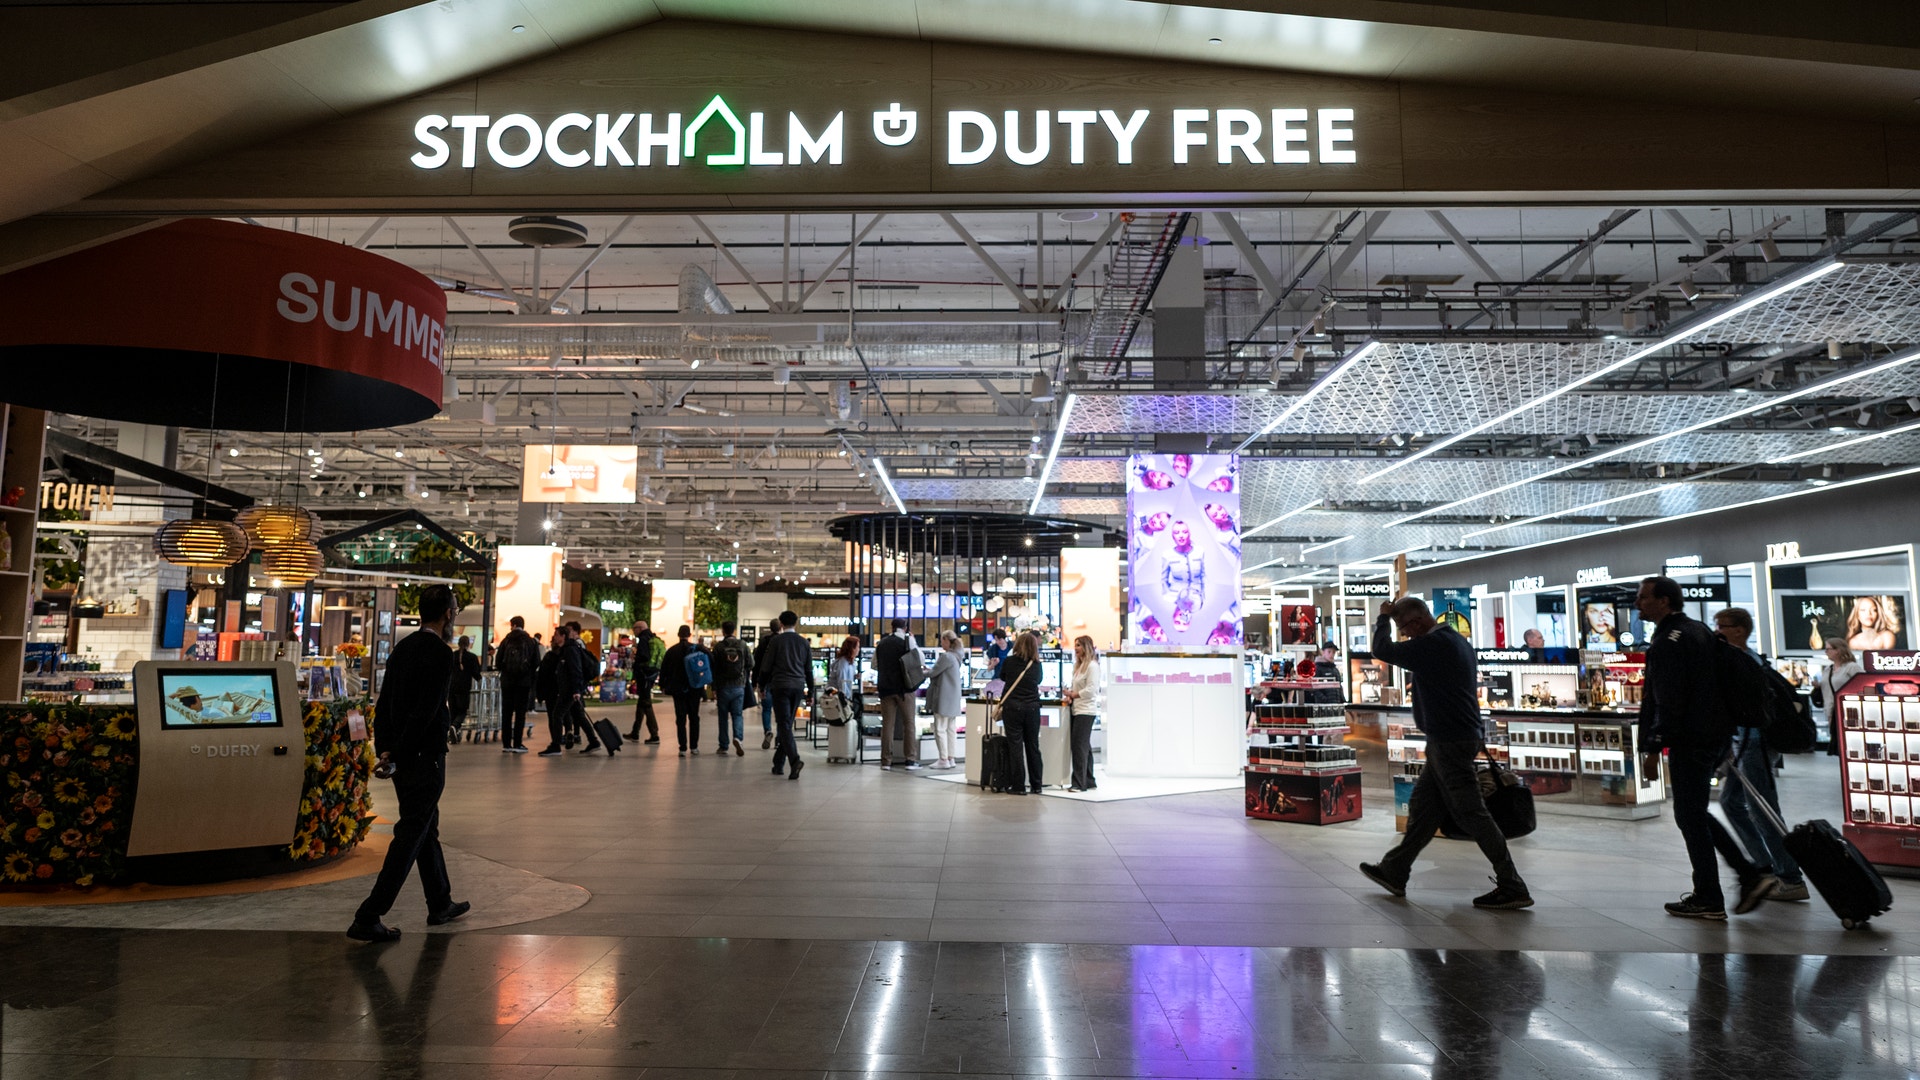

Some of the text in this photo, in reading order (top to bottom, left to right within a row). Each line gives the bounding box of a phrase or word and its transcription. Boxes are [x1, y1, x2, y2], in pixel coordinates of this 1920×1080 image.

[410, 95, 1357, 169] STOCKHOLM DUTY FREE
[40, 481, 115, 512] TCHEN
[1766, 541, 1800, 560] DIOR
[1576, 566, 1611, 583] CHANEL
[1344, 584, 1390, 593] TOM FORD
[1681, 587, 1713, 598] BOSS
[800, 616, 830, 626] PLEASE
[830, 616, 846, 626] PAY
[1477, 650, 1529, 660] rabanne
[1871, 651, 1920, 671] benef
[206, 744, 260, 758] DUFRY
